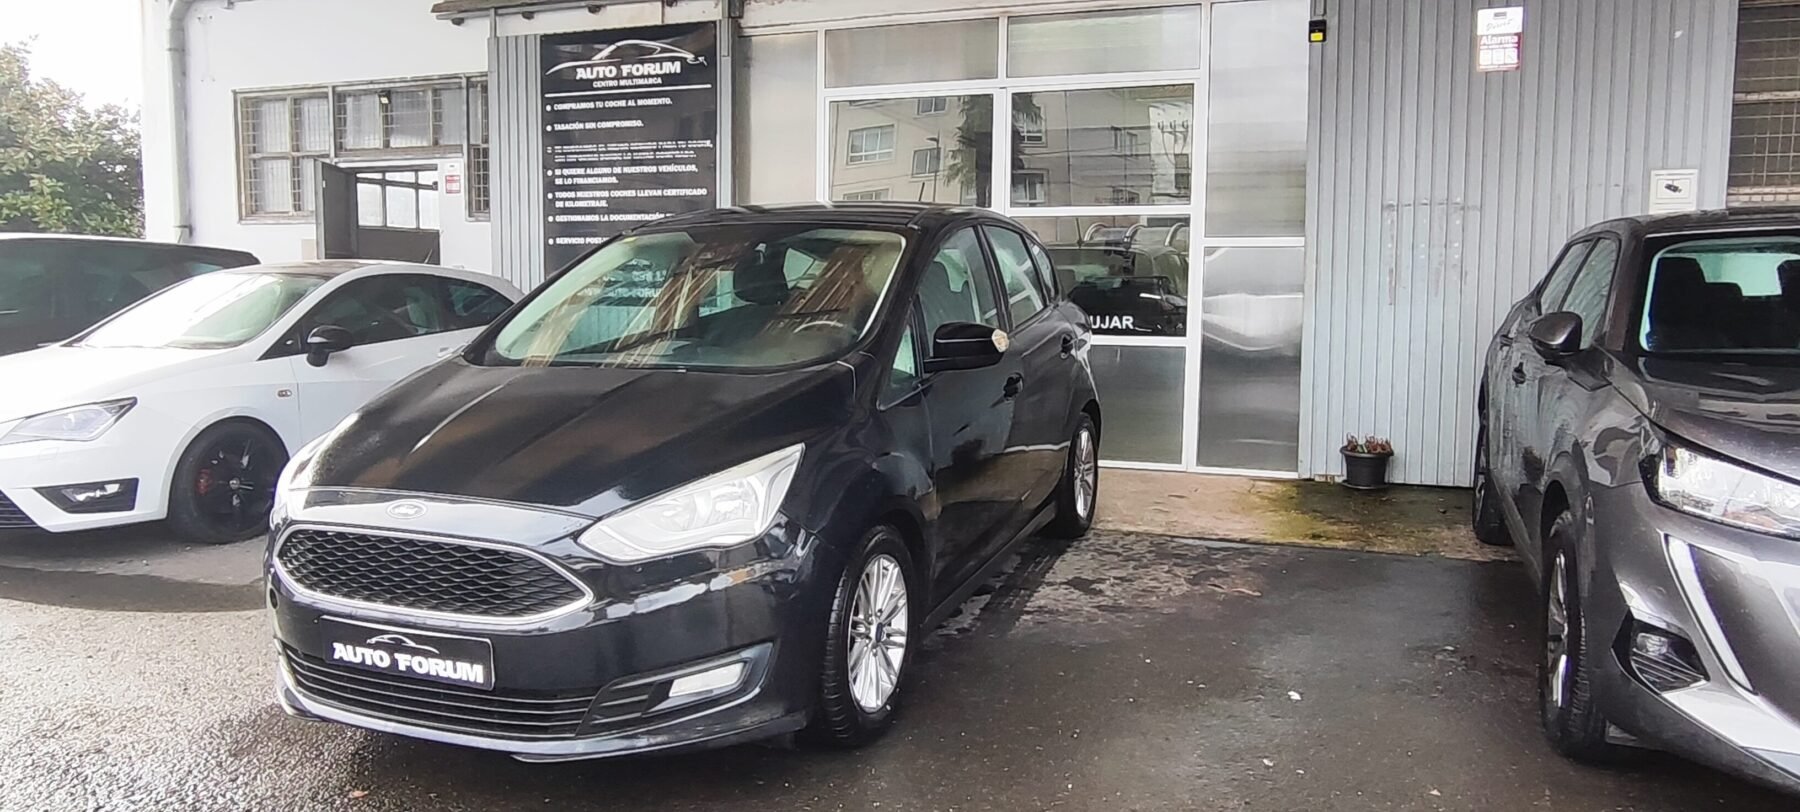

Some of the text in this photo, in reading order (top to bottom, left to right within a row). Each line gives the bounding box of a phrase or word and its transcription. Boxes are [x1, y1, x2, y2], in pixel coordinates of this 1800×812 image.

[1480, 35, 1518, 45] Alarma
[576, 61, 681, 80] AUTO FORUM
[593, 77, 662, 88] CENTRO MULTIMARCA
[554, 98, 672, 111] COMPRAMOS TU COCHE AL MOMENTO.
[554, 121, 584, 131] TASACIÓN
[597, 120, 644, 129] COMPROMISO.
[562, 168, 585, 176] QUIERE
[586, 167, 612, 175] ALGUNO
[623, 165, 657, 173] NUESTROS
[658, 163, 698, 172] VEHÍCULOS,
[564, 177, 572, 185] LO
[573, 176, 619, 184] FINANCIAMOS.
[555, 191, 575, 199] TODOS
[577, 190, 609, 198] NUESTROS
[637, 189, 662, 197] LLEVAN
[663, 188, 707, 196] CERTIFICADO
[565, 200, 608, 208] KILOMETRAJE.
[555, 214, 599, 222] GESTIONAMOS
[556, 237, 584, 245] SERVICIO
[332, 642, 484, 684] AUTO FORUM
